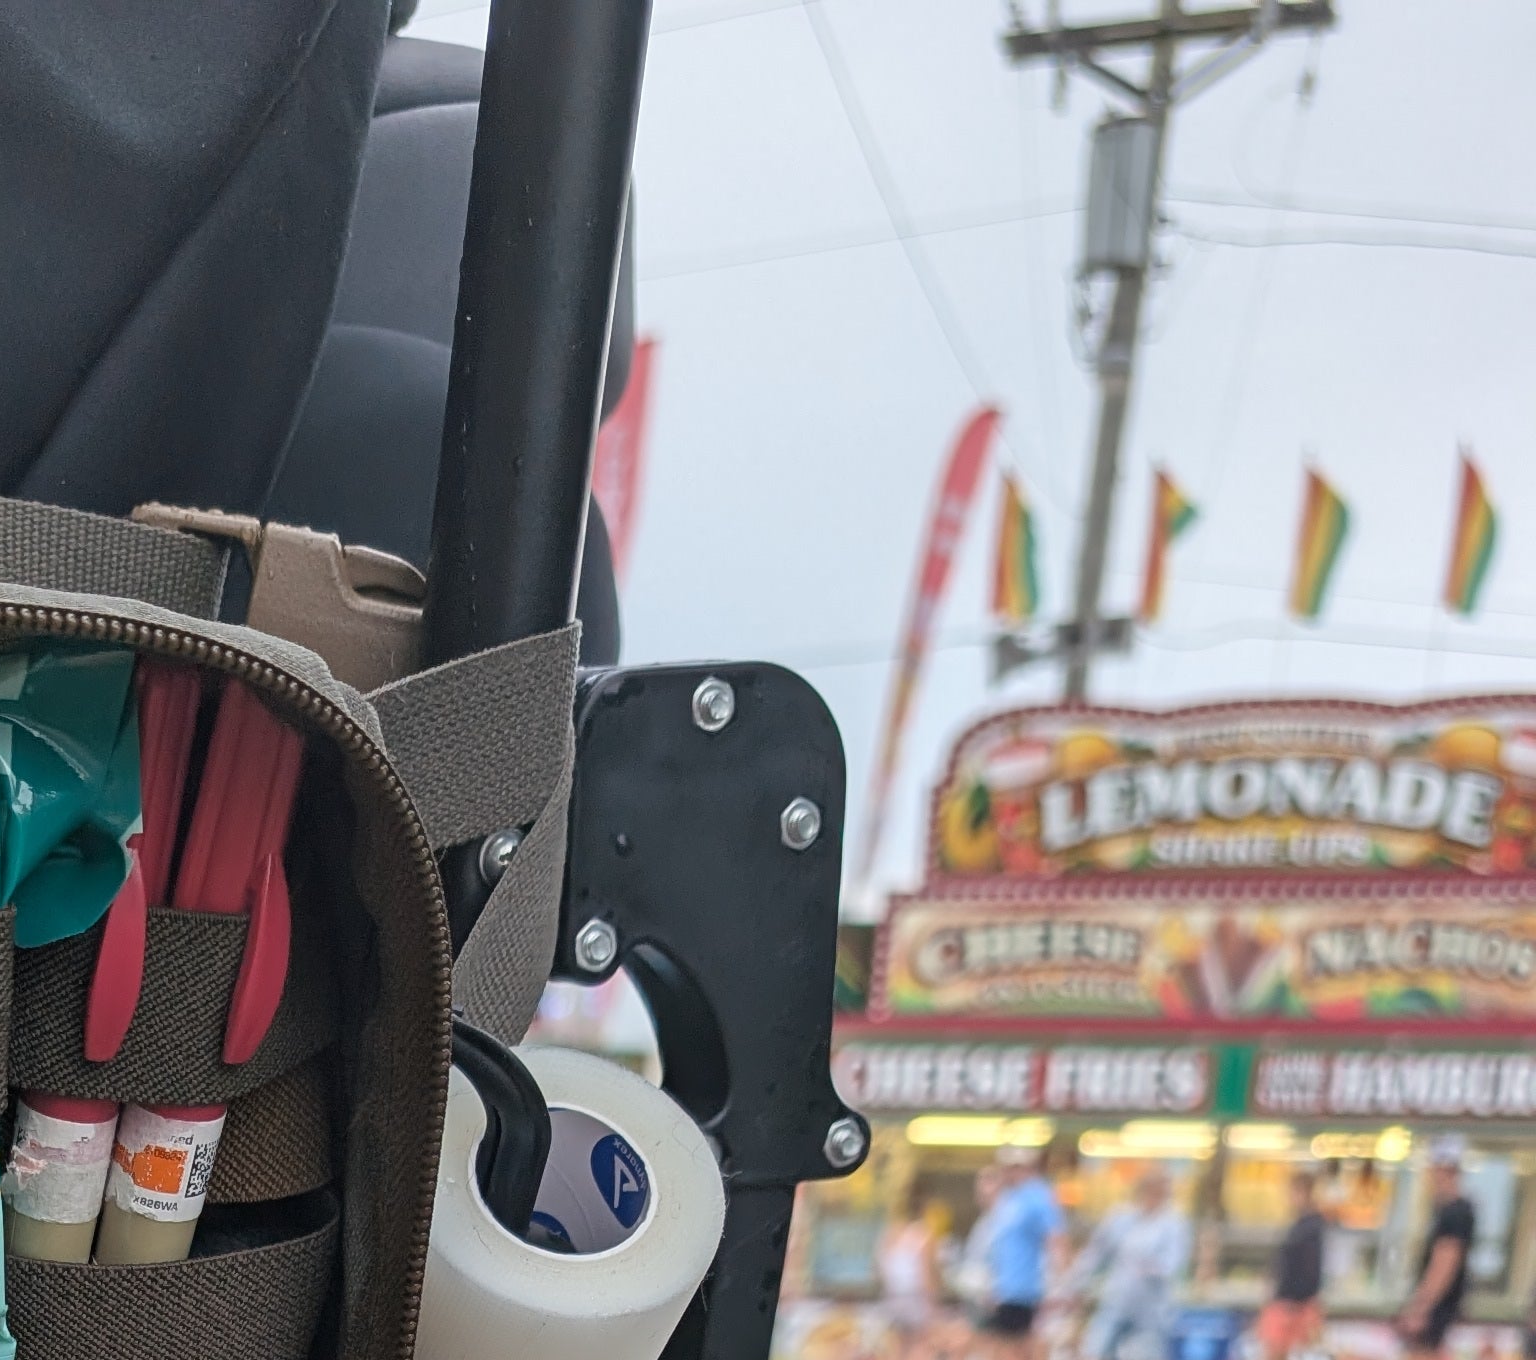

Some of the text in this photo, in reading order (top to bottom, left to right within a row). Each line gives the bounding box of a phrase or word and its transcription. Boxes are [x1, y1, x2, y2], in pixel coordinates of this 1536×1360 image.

[1041, 756, 1505, 853] LEMONADE
[831, 1043, 1032, 1110] CHEESE
[1044, 1044, 1210, 1111] FRIES
